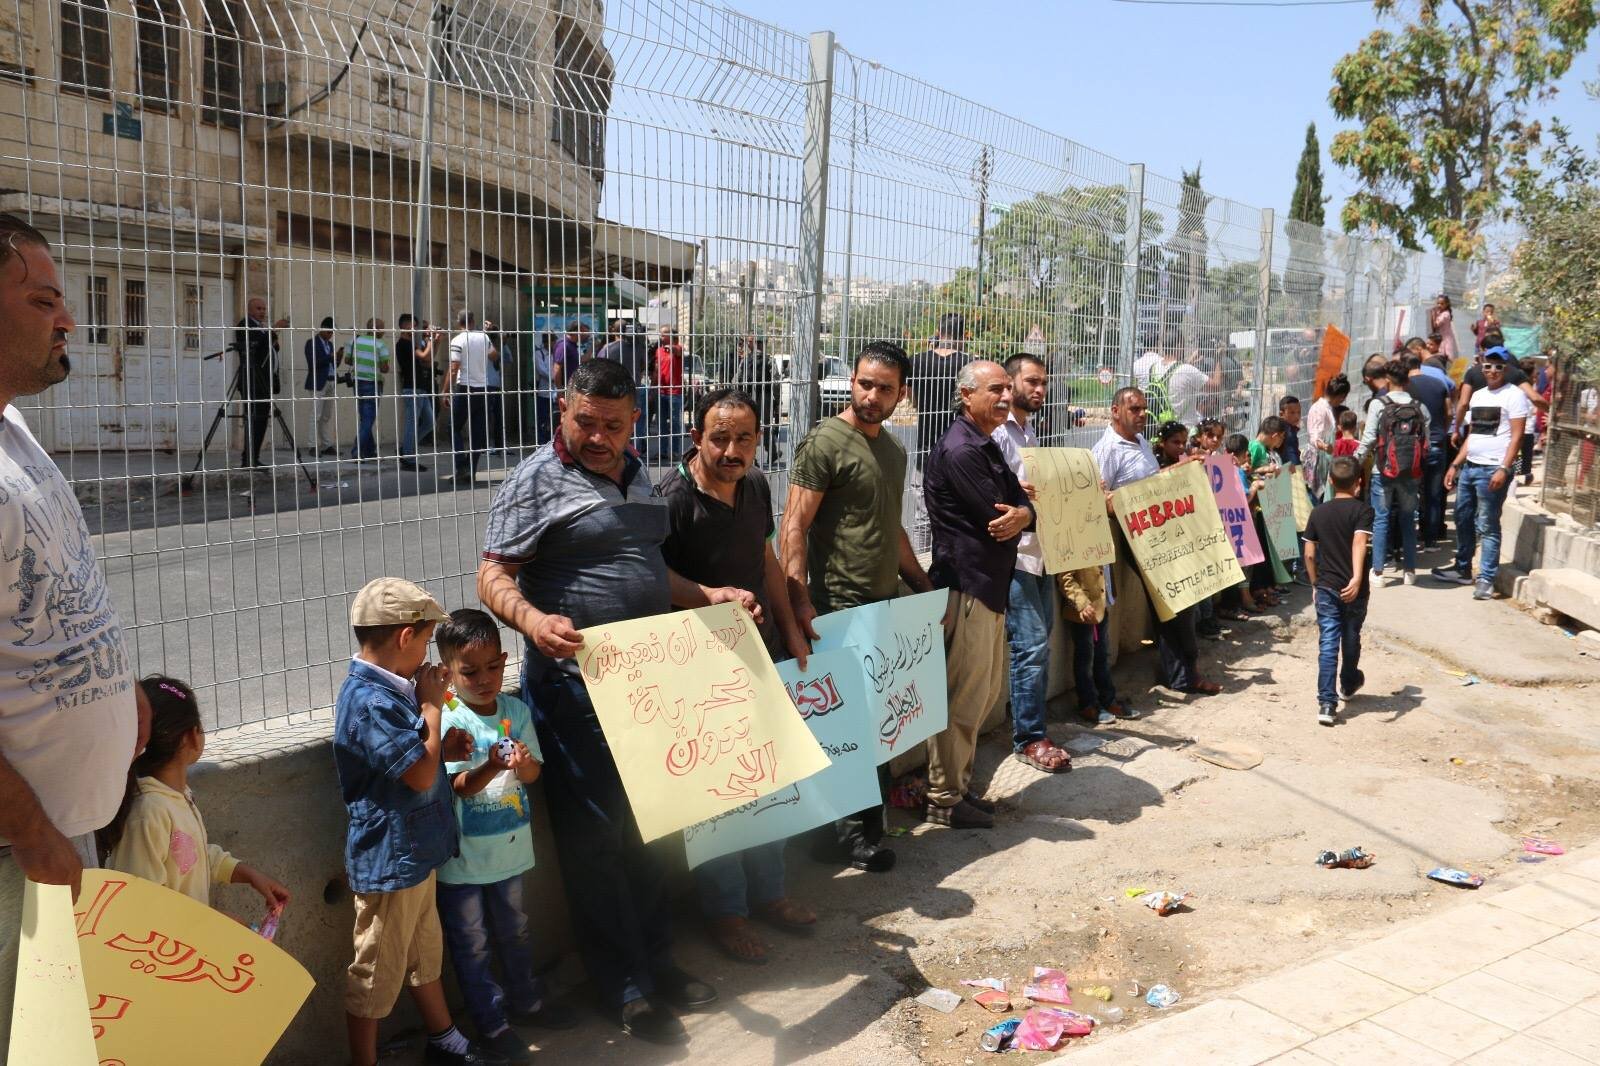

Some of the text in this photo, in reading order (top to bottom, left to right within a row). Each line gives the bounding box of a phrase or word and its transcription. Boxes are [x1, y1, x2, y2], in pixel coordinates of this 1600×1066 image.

[1124, 494, 1196, 540] HEBRON
[1174, 523, 1186, 538] A
[1165, 558, 1235, 599] SETTLEMENT
[706, 608, 747, 654] نريد
[583, 632, 666, 686] نعيش
[103, 930, 256, 994] نريد
